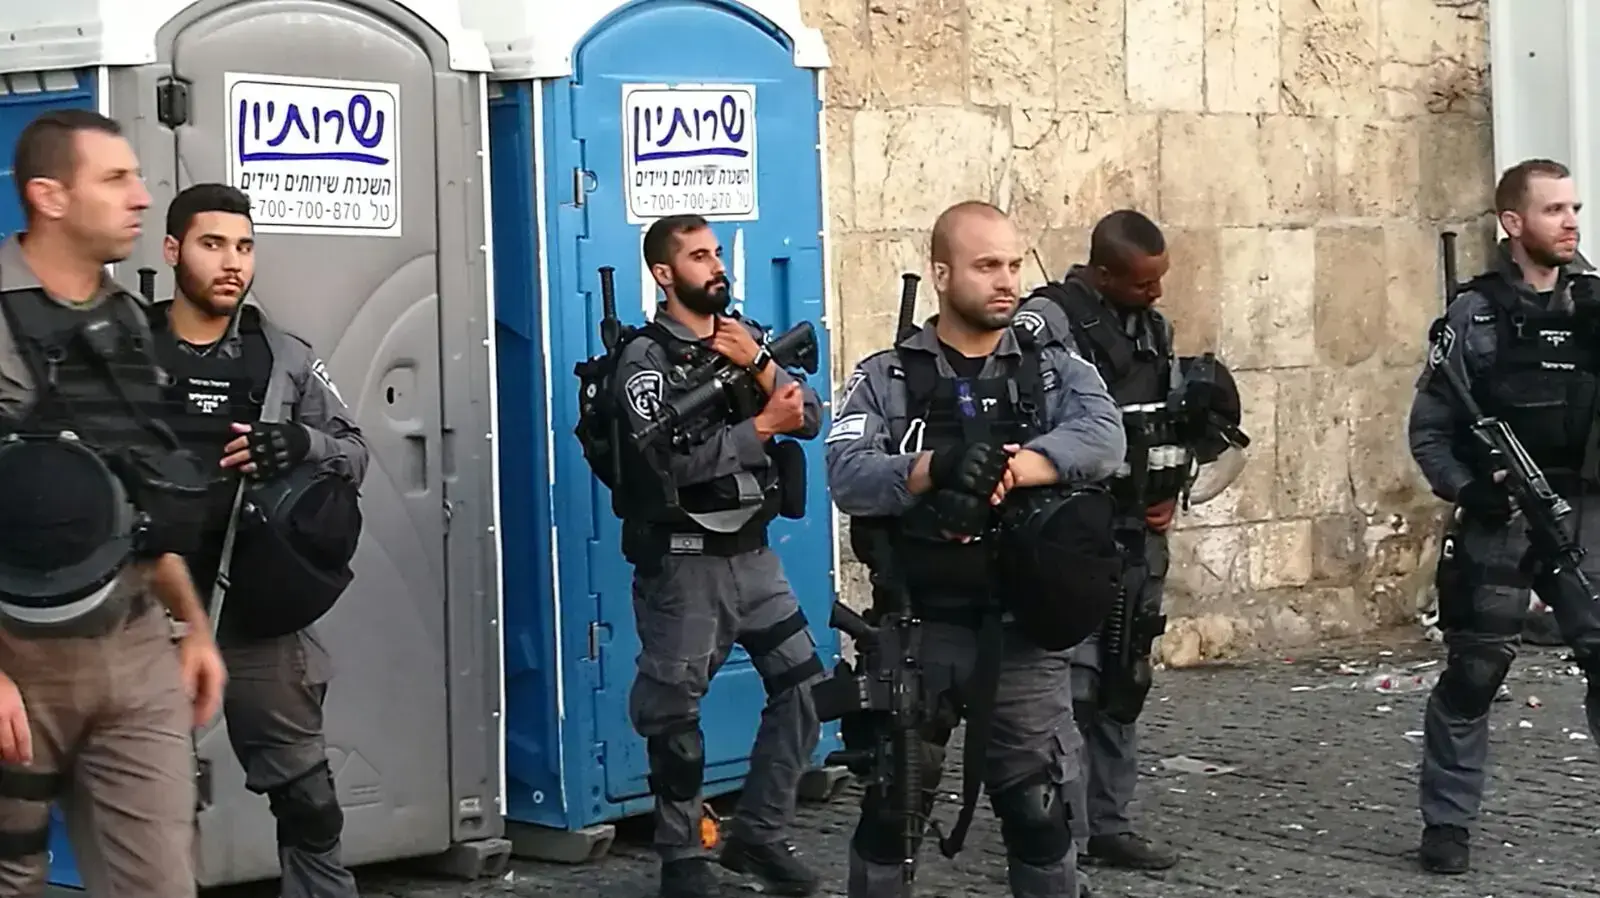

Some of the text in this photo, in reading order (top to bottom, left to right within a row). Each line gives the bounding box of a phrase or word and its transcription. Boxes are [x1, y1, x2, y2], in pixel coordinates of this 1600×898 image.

[239, 94, 389, 167] שרותיון
[634, 95, 748, 166] שרותיון
[241, 172, 391, 195] השכרת שירותים ניידים
[636, 171, 668, 187] ניידים
[718, 169, 750, 185] השכרת
[251, 199, 390, 221] טל -700-700-870
